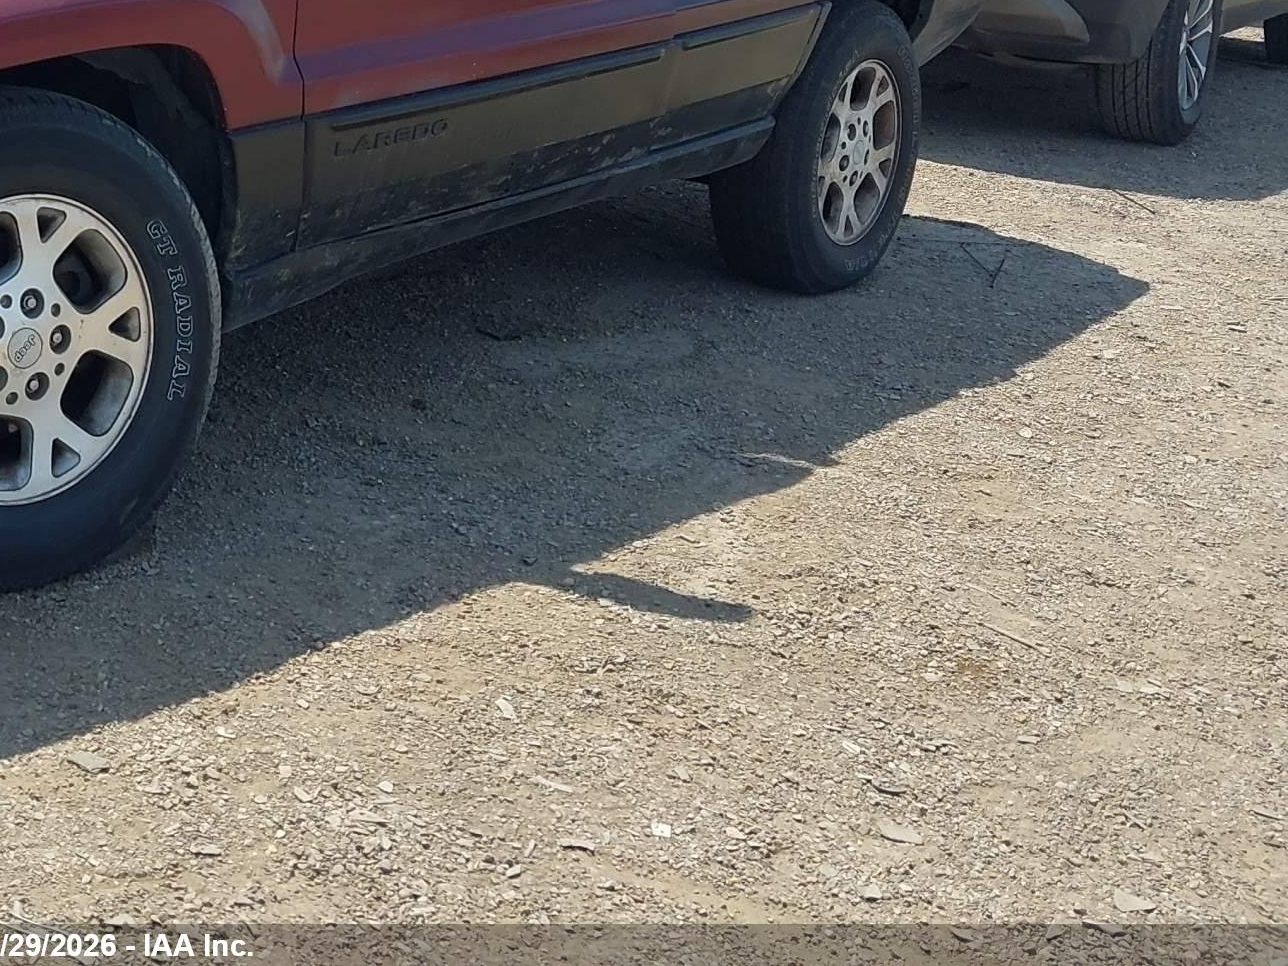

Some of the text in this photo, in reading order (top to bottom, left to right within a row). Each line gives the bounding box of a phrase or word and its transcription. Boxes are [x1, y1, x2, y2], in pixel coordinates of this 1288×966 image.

[333, 118, 448, 159] LAREDO
[146, 219, 194, 401] GT RADIAL
[14, 334, 36, 363] Jeep
